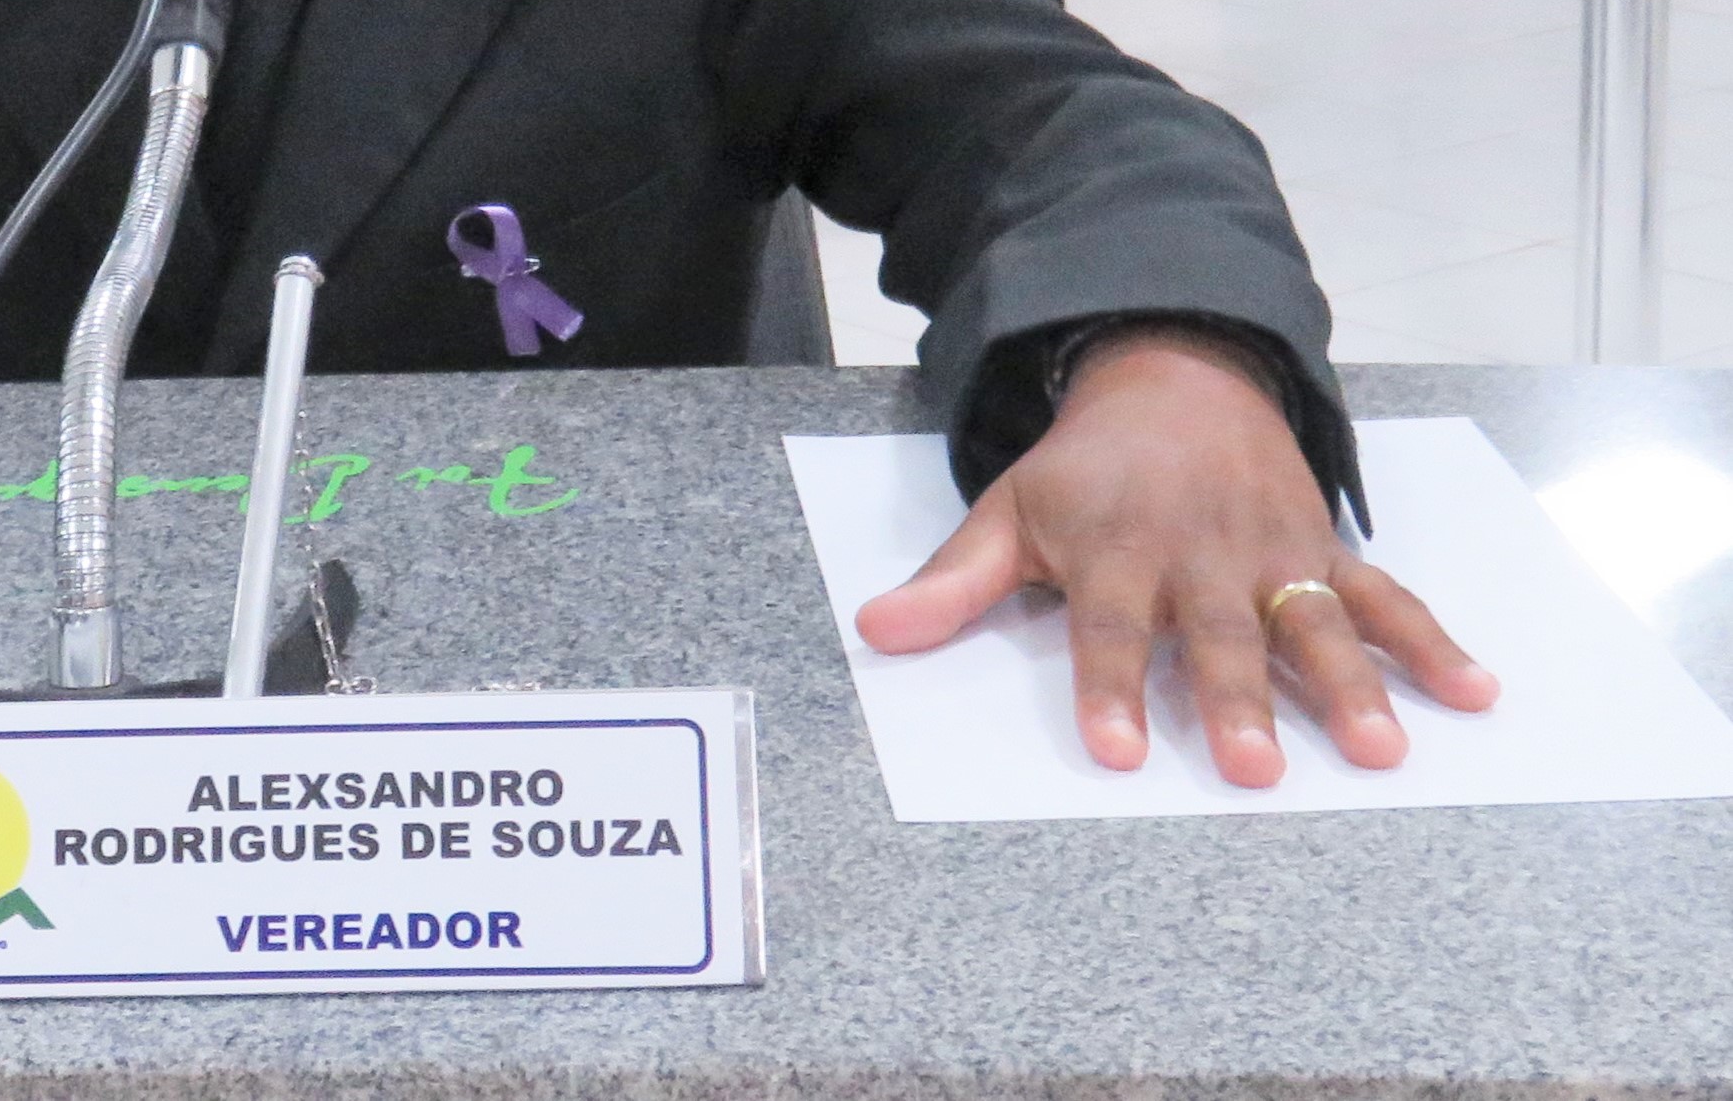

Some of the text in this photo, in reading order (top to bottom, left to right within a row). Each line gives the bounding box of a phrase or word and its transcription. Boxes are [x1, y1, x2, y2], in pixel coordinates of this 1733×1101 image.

[188, 769, 564, 812] ALEXSANDRO
[55, 819, 682, 866] RODRIGUES DE SOUZA
[217, 911, 522, 953] VEREADOR
